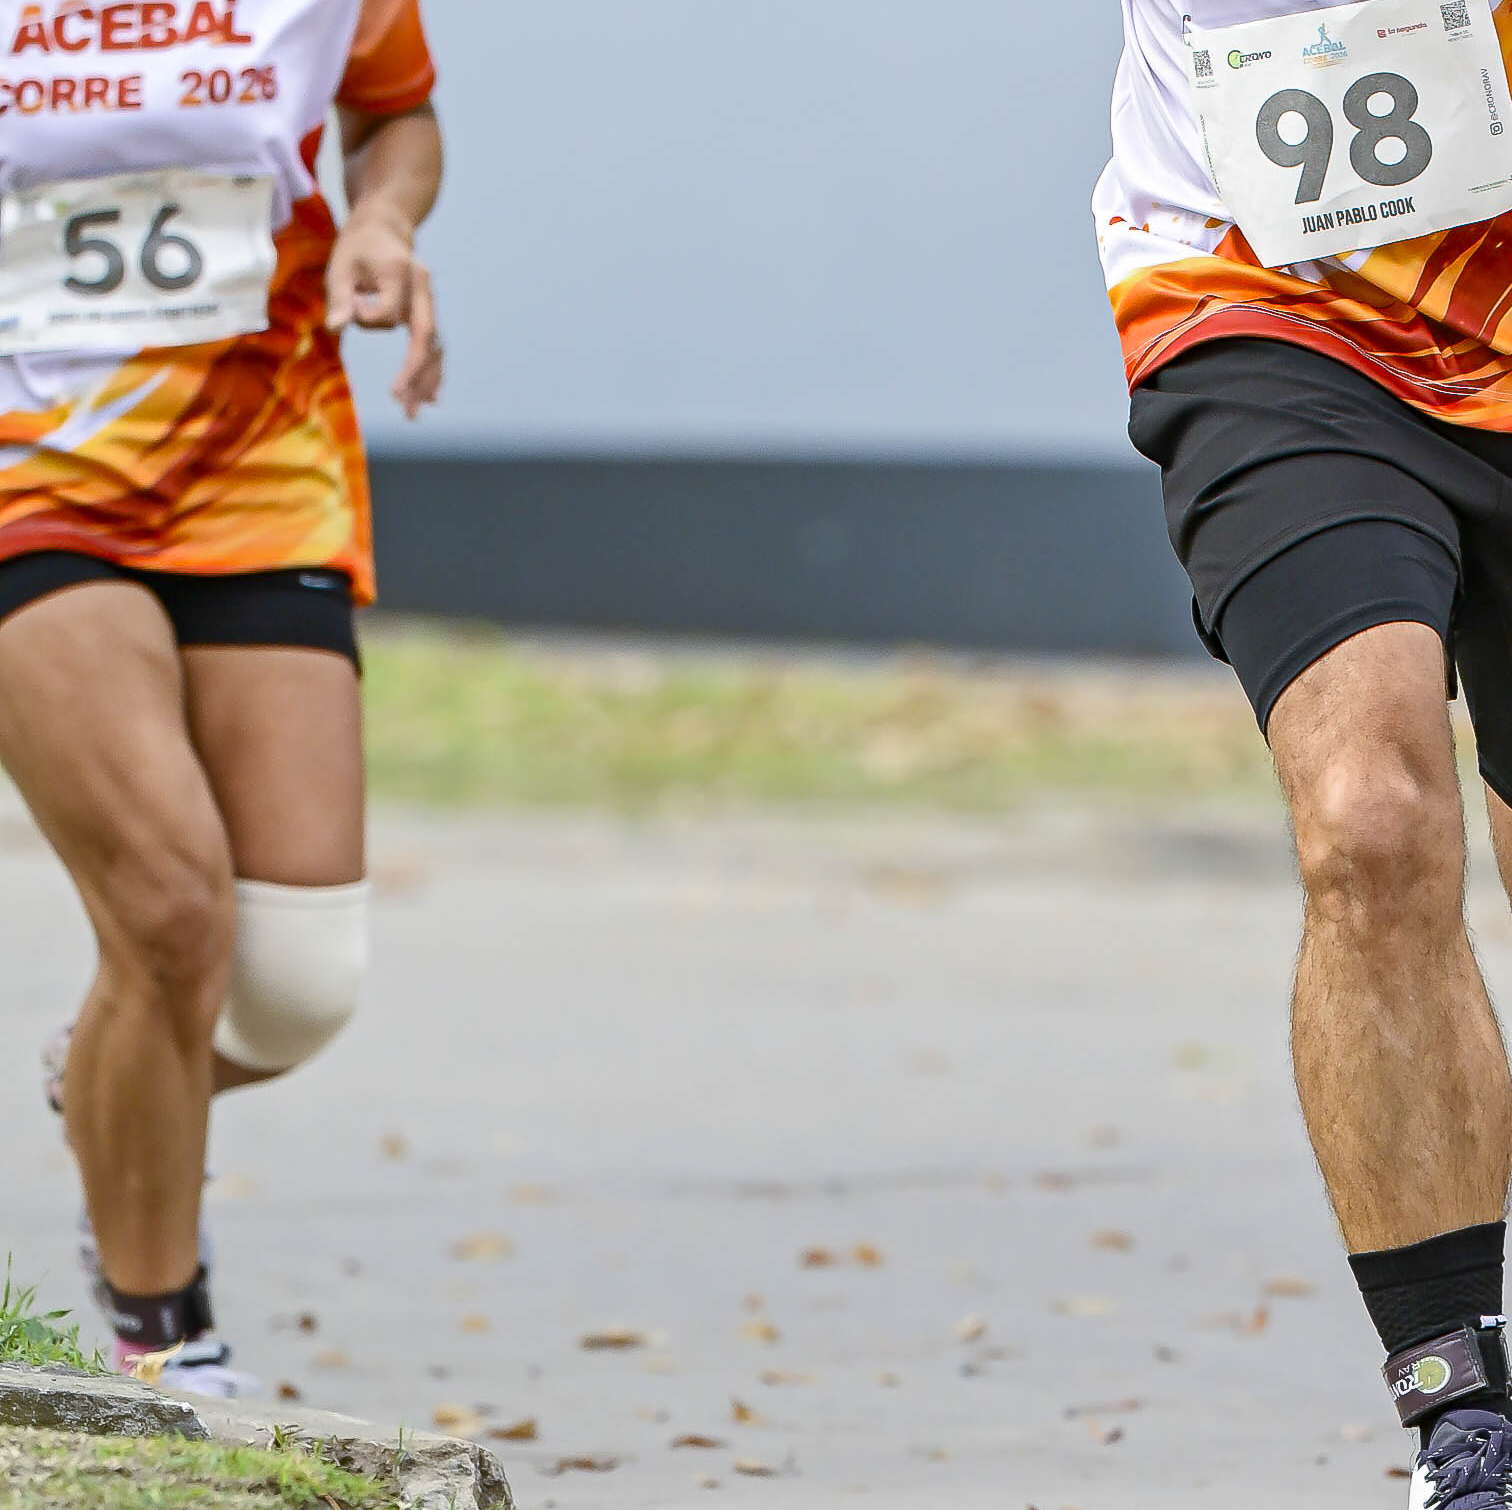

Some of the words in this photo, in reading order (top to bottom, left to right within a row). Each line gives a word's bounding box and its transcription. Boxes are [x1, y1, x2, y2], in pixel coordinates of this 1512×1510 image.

[1255, 71, 1433, 205] 98
[63, 202, 203, 294] 56
[1302, 212, 1335, 235] JUAN
[1335, 204, 1378, 227] PABLO
[1379, 196, 1416, 219] COOK
